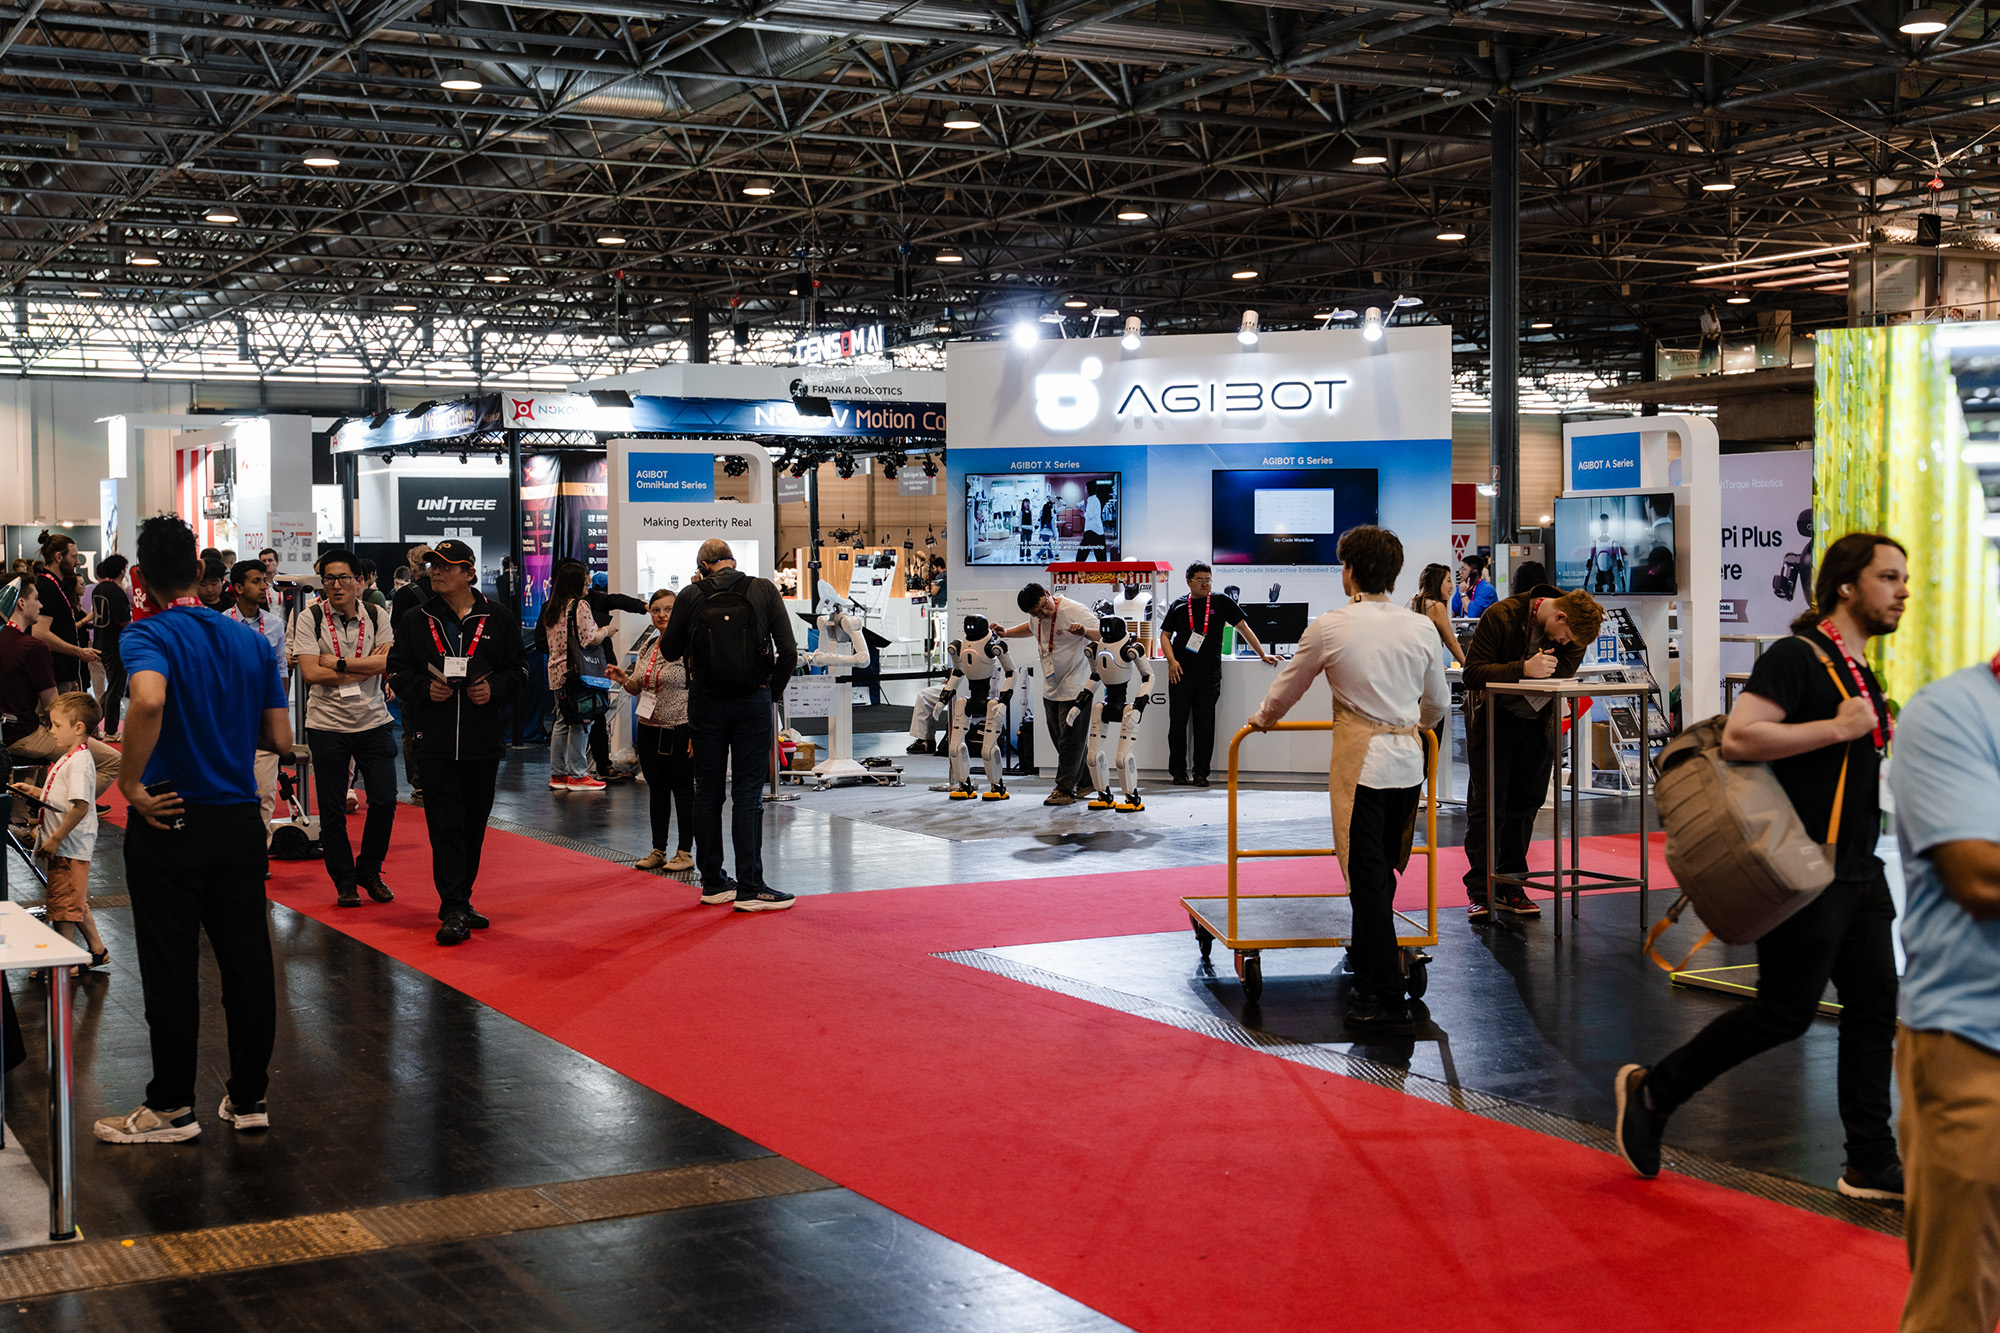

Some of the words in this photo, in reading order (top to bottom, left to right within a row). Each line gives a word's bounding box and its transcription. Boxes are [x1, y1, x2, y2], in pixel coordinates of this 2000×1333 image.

[812, 385, 852, 394] FRANKA
[855, 386, 903, 396] ROBOTICS
[1117, 380, 1347, 415] AGIBOT
[855, 411, 915, 430] Motion
[1010, 461, 1042, 470] AGIBOT
[1044, 461, 1051, 469] X
[1054, 460, 1080, 469] Series
[1262, 457, 1295, 465] AGIBOT
[1297, 457, 1304, 465] G
[1306, 456, 1333, 465] Series
[1578, 459, 1603, 470] AGIBOT
[1605, 459, 1611, 469] A
[1612, 458, 1634, 469] Series
[636, 470, 668, 479] AGIBOT
[636, 480, 679, 490] OmniHand
[681, 481, 707, 490] Series
[1752, 478, 1783, 488] Robotics
[417, 496, 497, 513] UNITREE
[643, 517, 679, 529] Making
[682, 517, 728, 529] Dexterity
[731, 517, 752, 527] Real
[1721, 525, 1737, 548] Pi
[1742, 526, 1783, 548] Plus
[1721, 563, 1742, 580] re
